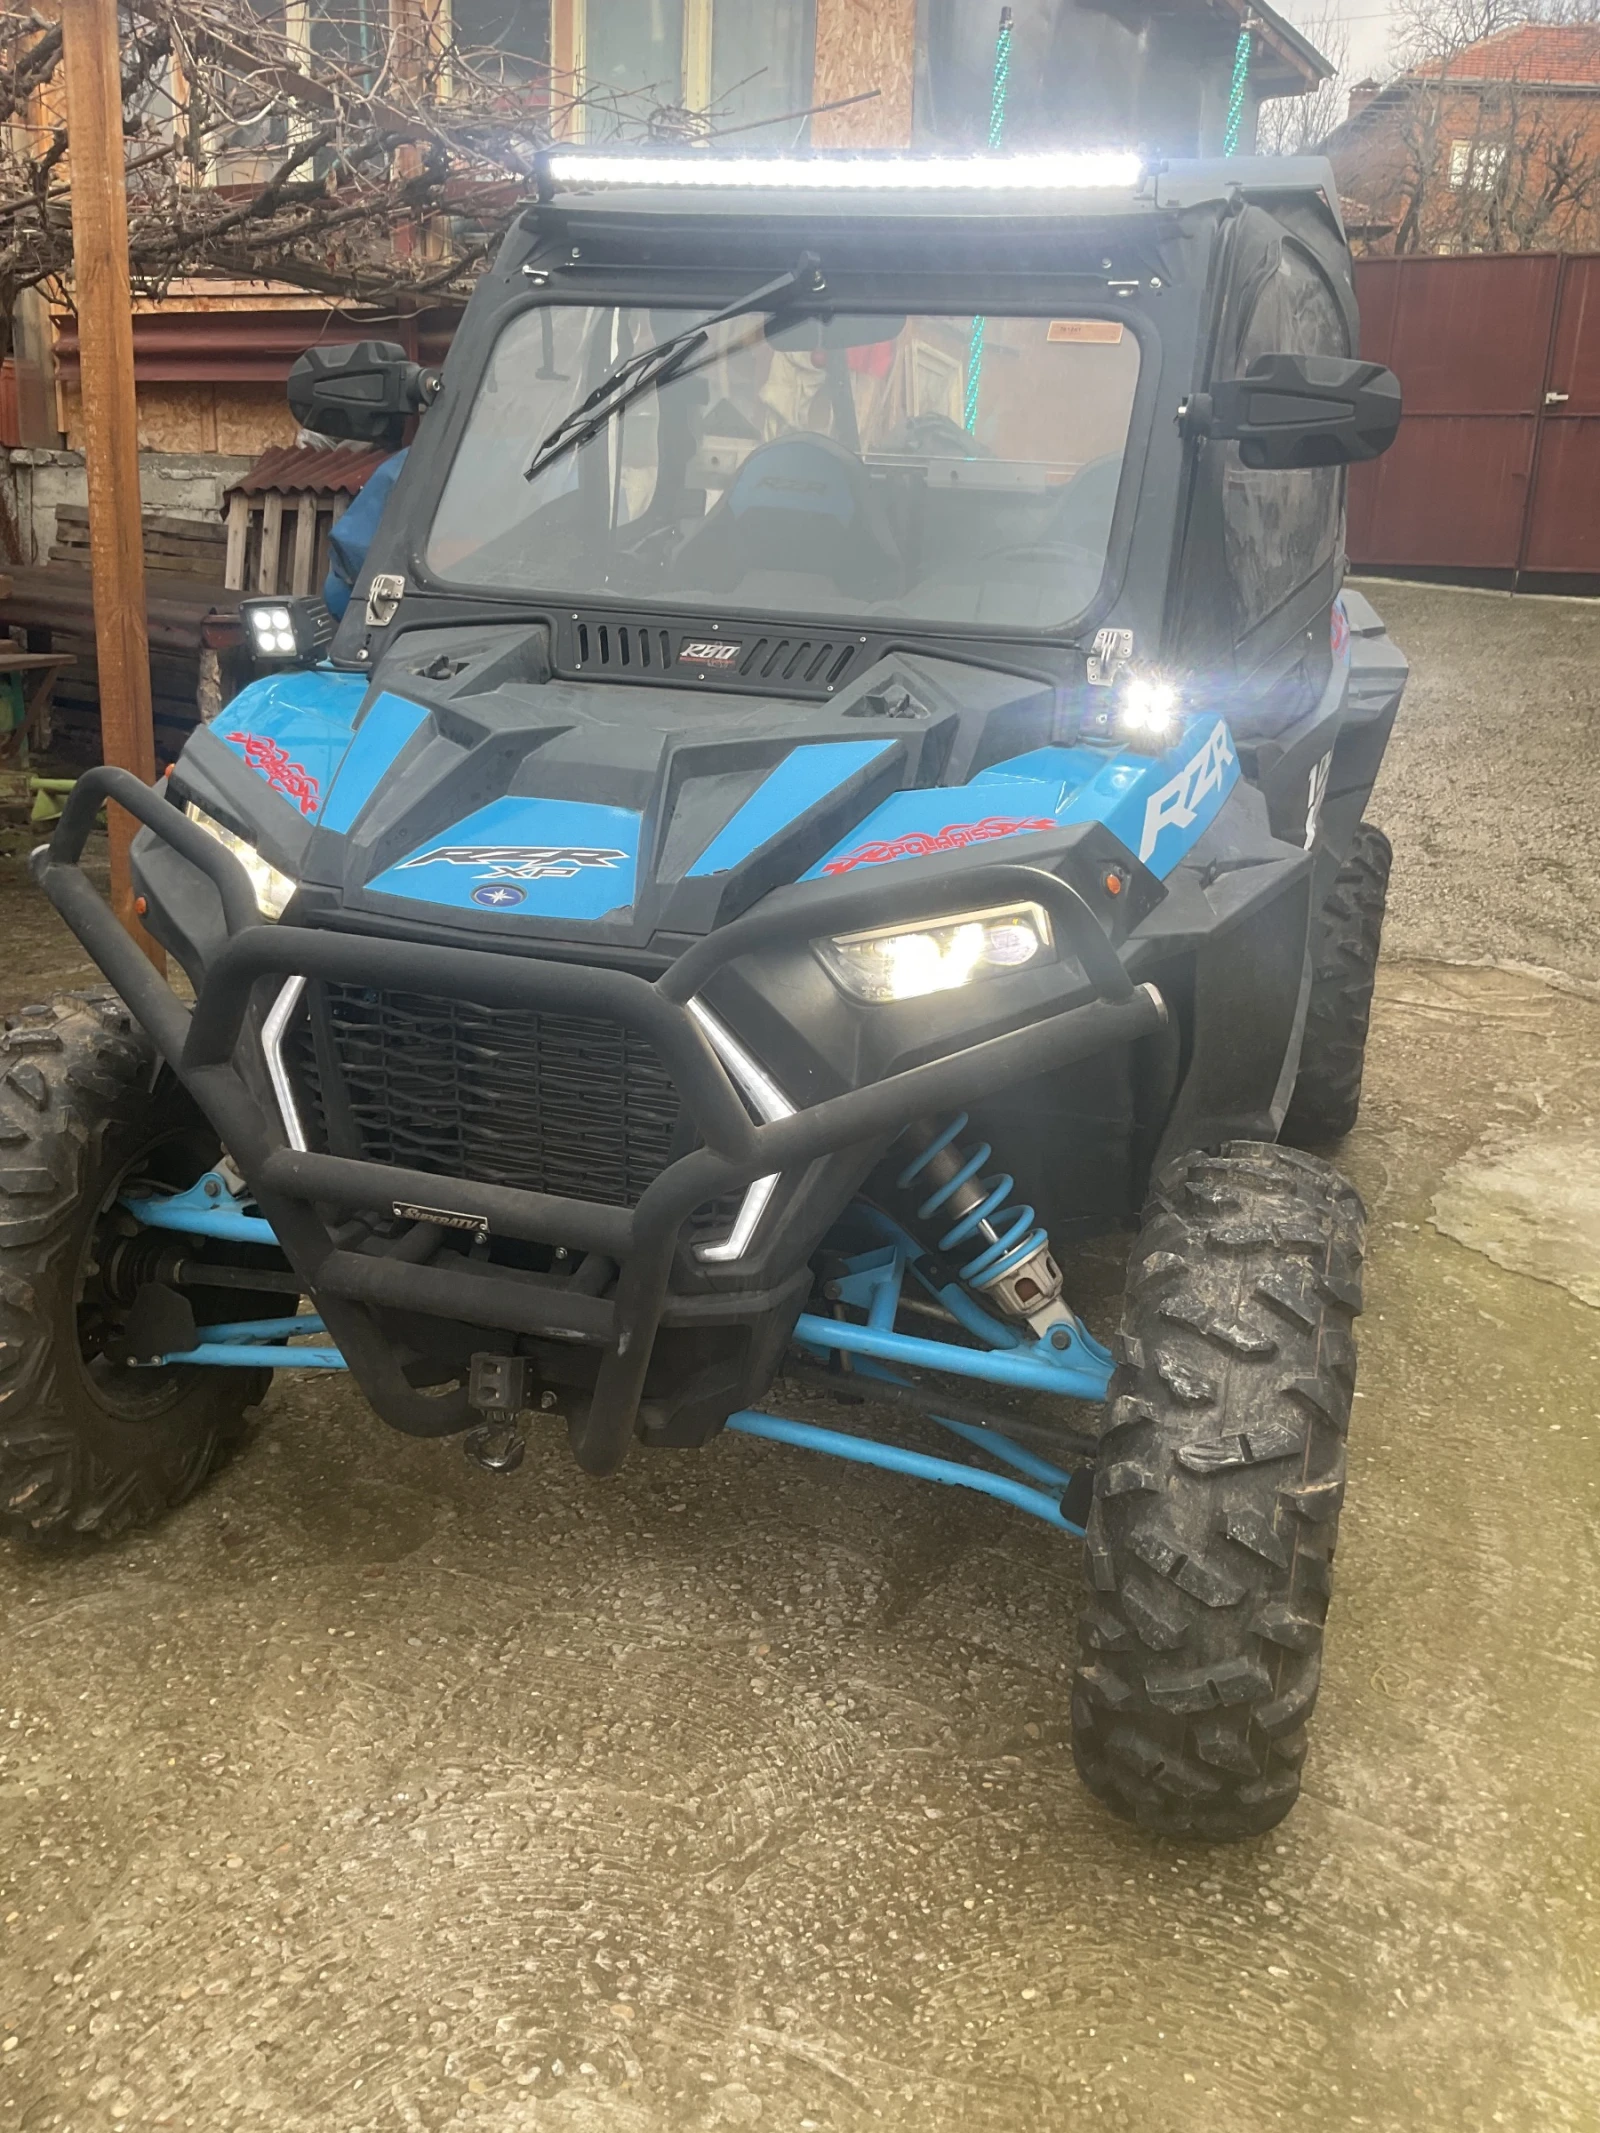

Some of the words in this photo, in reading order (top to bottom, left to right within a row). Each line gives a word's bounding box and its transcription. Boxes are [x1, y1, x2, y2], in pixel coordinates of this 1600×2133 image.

[1138, 719, 1234, 863] RZR
[886, 825, 994, 859] POLARIS
[394, 845, 630, 868] RZR
[471, 865, 582, 879] XP
